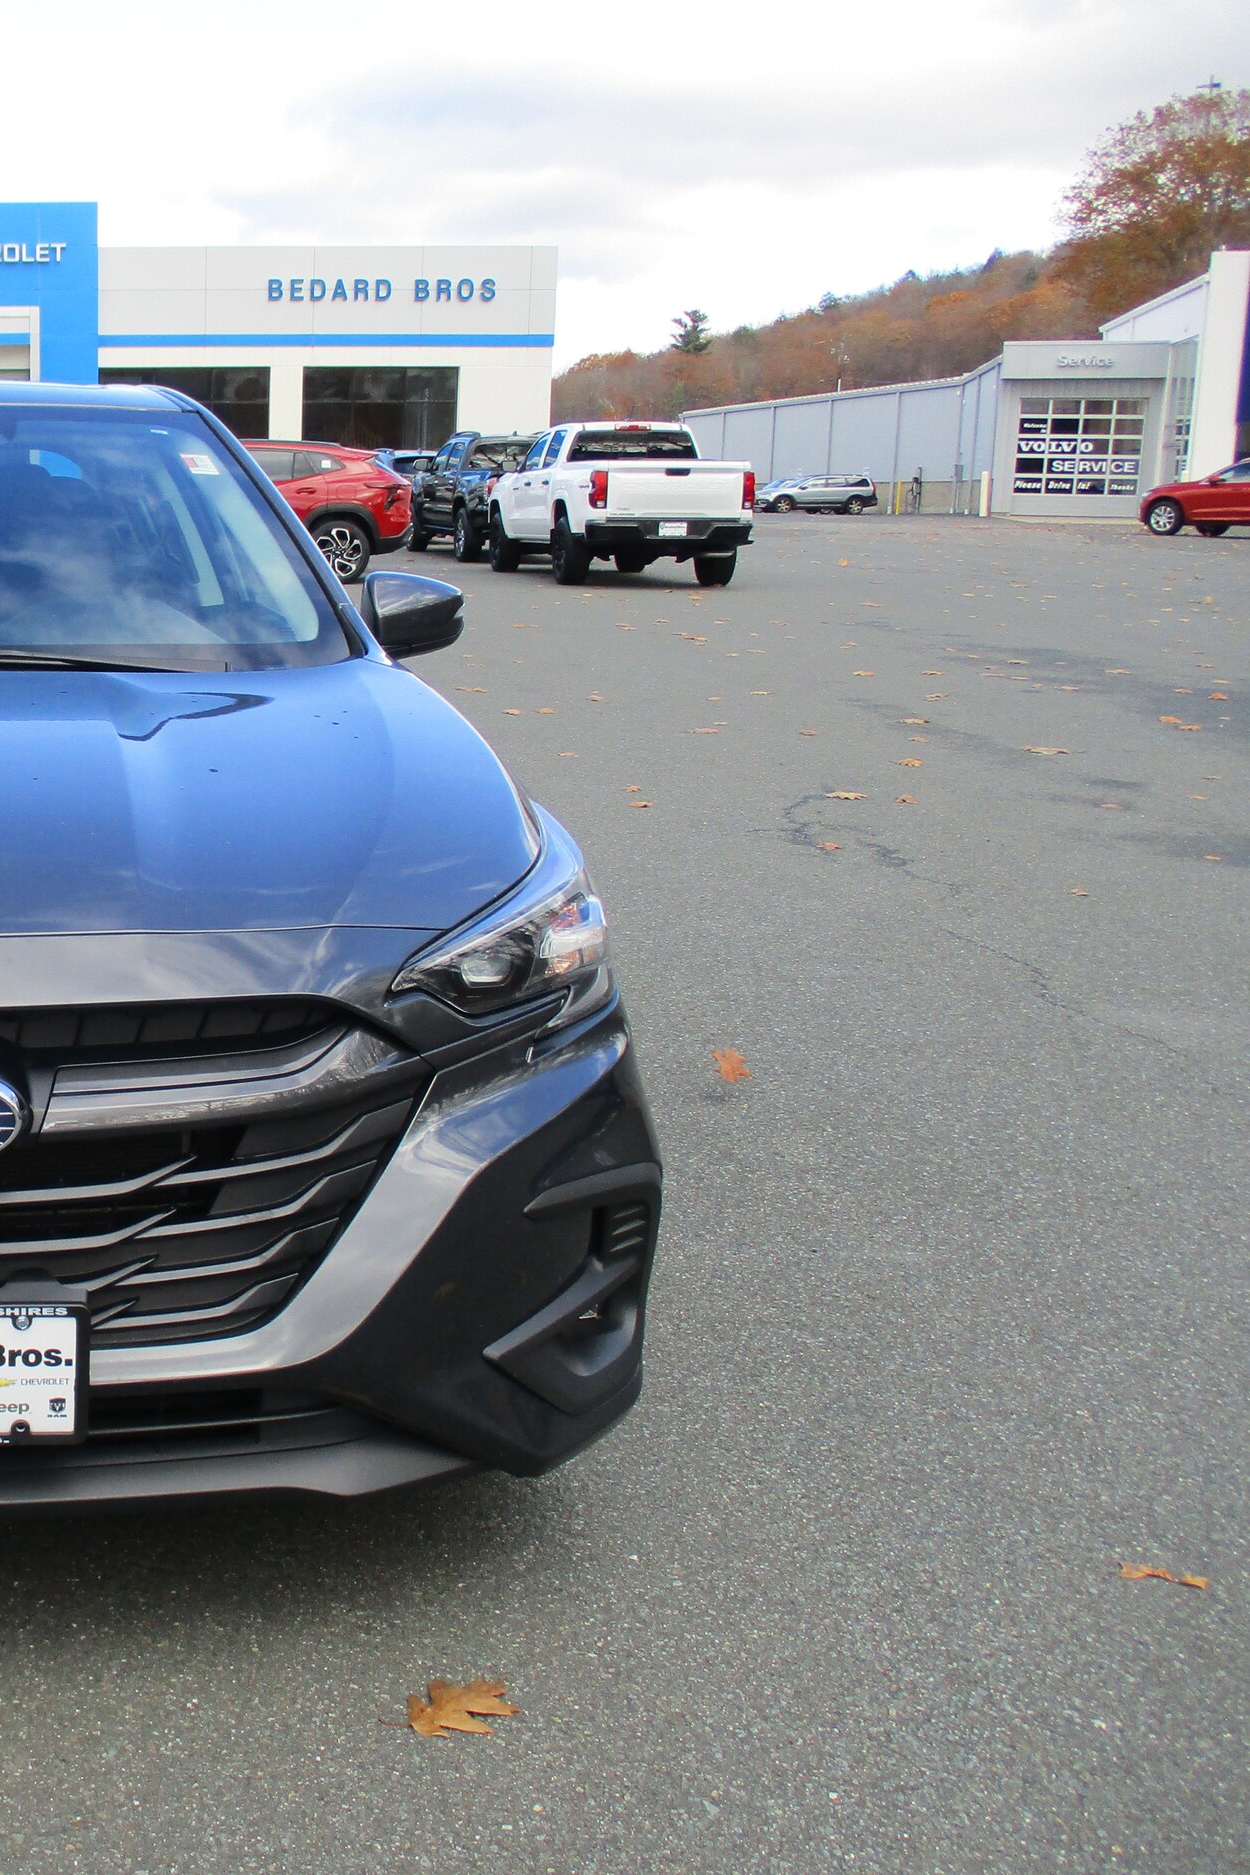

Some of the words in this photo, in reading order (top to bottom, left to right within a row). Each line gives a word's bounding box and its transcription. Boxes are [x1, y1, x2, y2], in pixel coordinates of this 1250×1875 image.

[267, 279, 392, 301] BEDARD
[414, 278, 496, 301] BROS
[1056, 354, 1114, 368] Service
[1018, 441, 1094, 452] VOLVO
[1051, 461, 1136, 472] SERVICE
[1014, 481, 1042, 489] Please
[1048, 481, 1071, 489] Drive
[20, 1378, 70, 1386] CHEVROLET
